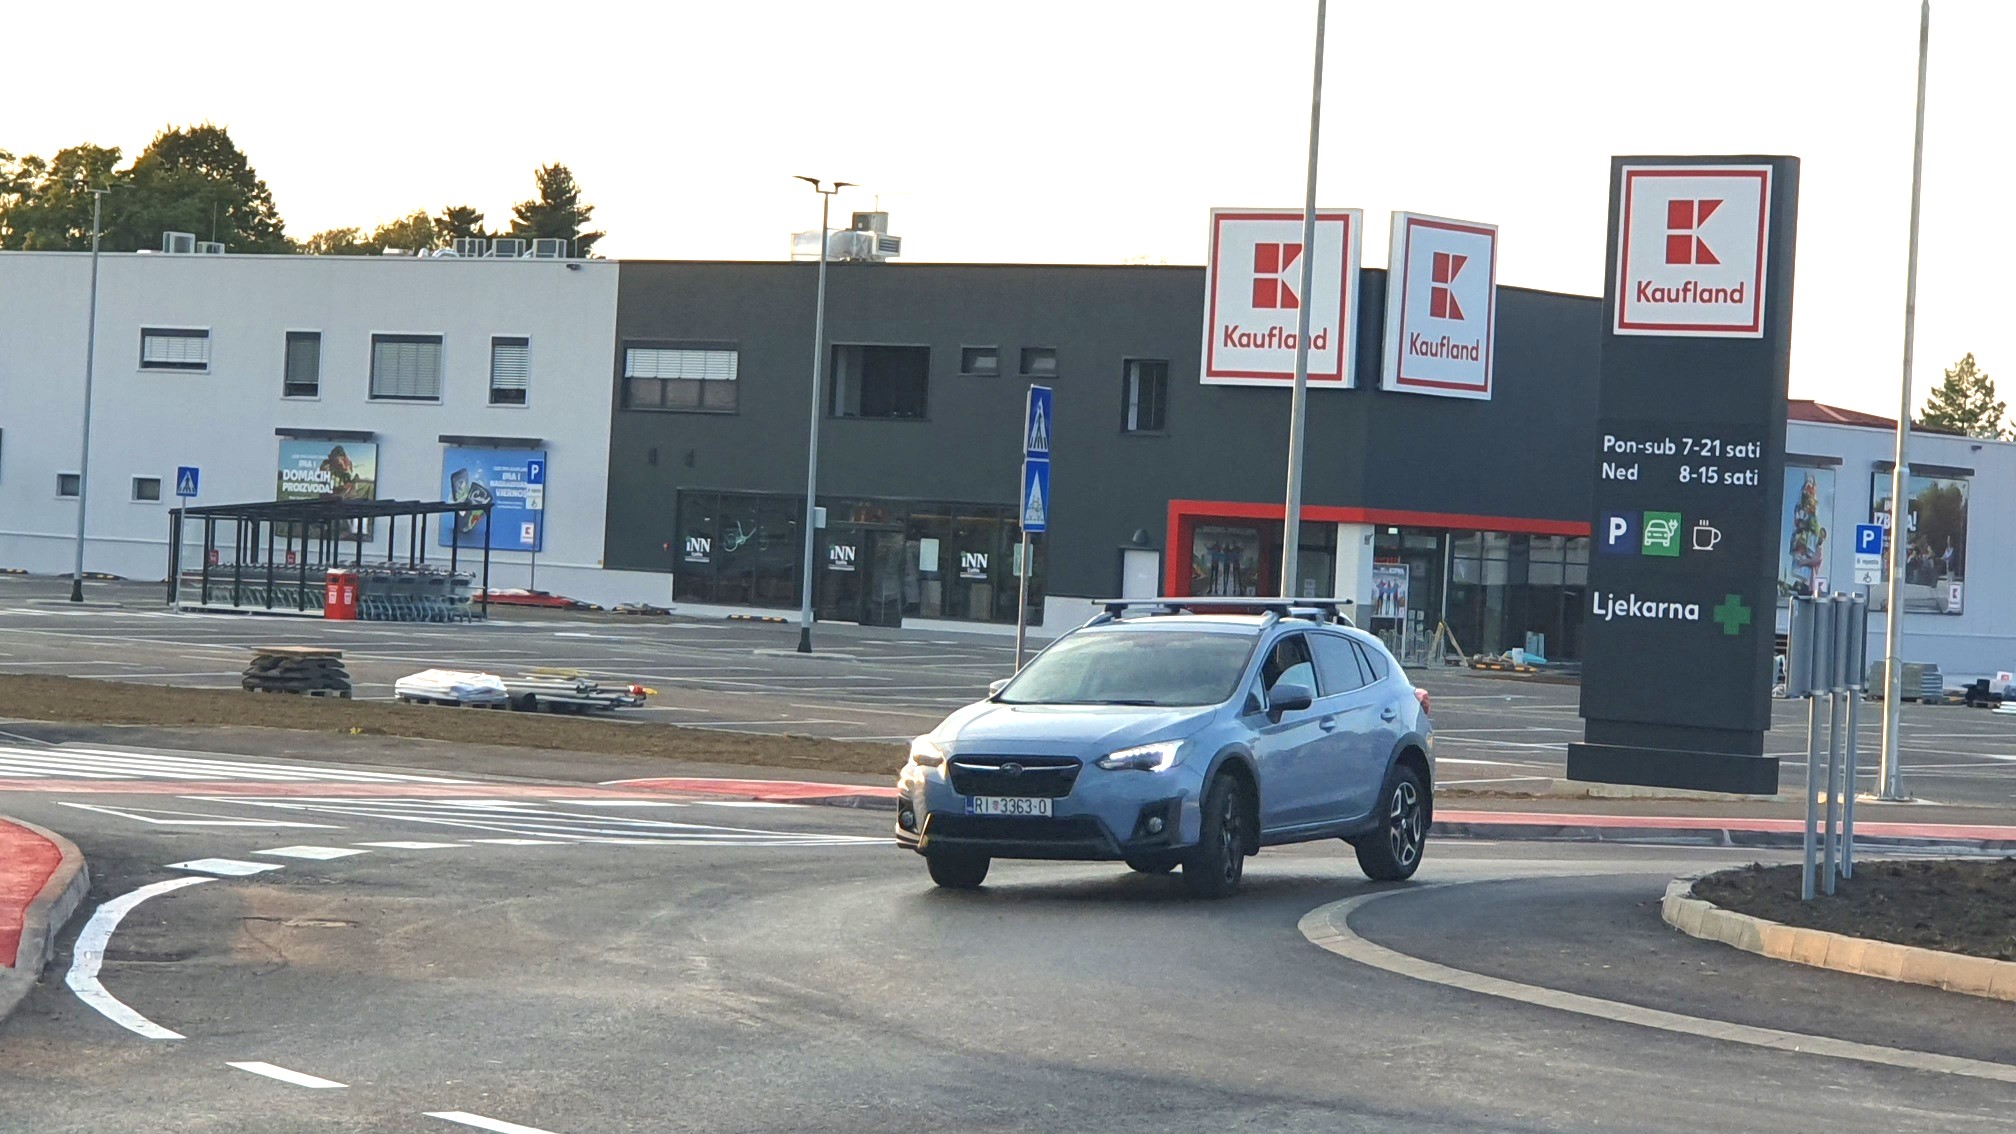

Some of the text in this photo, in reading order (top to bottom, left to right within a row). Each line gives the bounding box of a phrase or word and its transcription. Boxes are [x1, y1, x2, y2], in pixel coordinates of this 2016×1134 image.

[1665, 199, 1724, 265] K
[1636, 280, 1745, 304] Kaufland
[1409, 331, 1480, 362] Kaufland
[1603, 434, 1761, 459] Pon-sub 7-21 sati
[531, 464, 540, 480] P
[1602, 462, 1759, 486] Ned 8-15 sati
[1608, 516, 1627, 545] P
[1862, 529, 1875, 549] P
[1592, 591, 1700, 621] Ljekarna
[975, 797, 989, 813] RI
